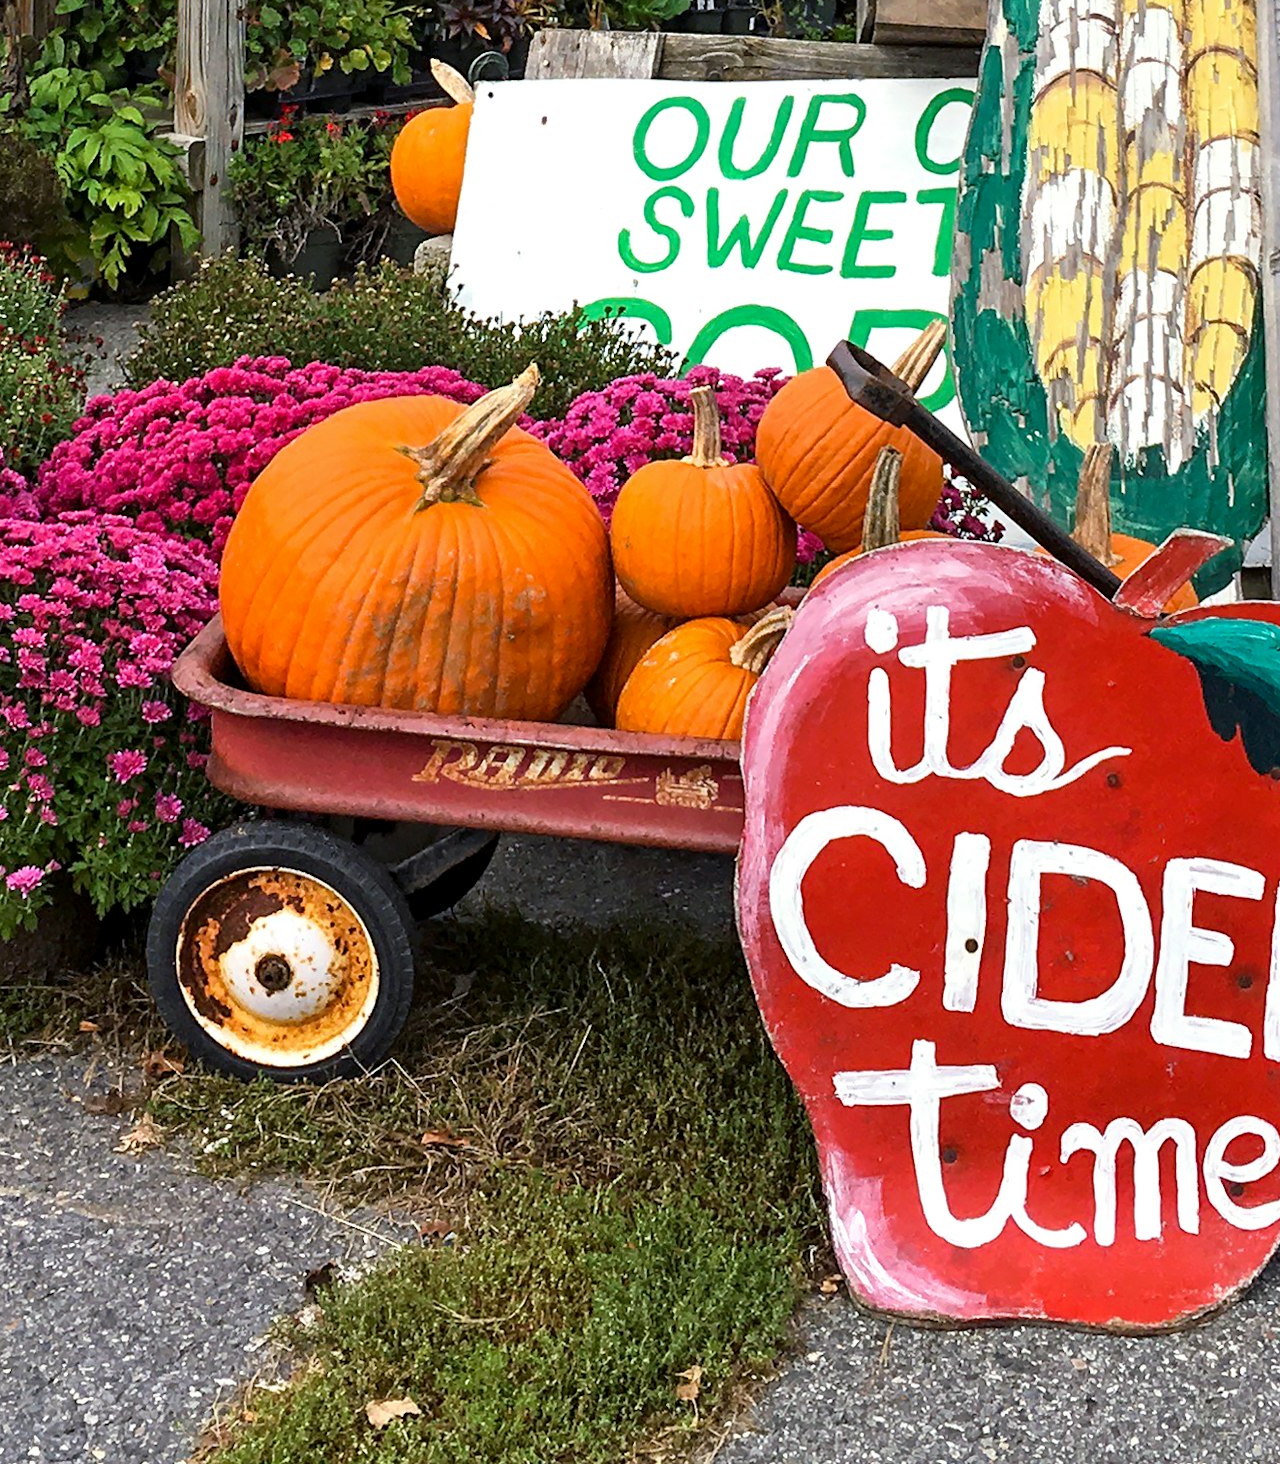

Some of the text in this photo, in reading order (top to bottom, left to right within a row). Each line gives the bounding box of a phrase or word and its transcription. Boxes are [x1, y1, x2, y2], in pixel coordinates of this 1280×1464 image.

[632, 92, 867, 181] OUR
[617, 184, 958, 279] SWEET
[863, 605, 1133, 797] its
